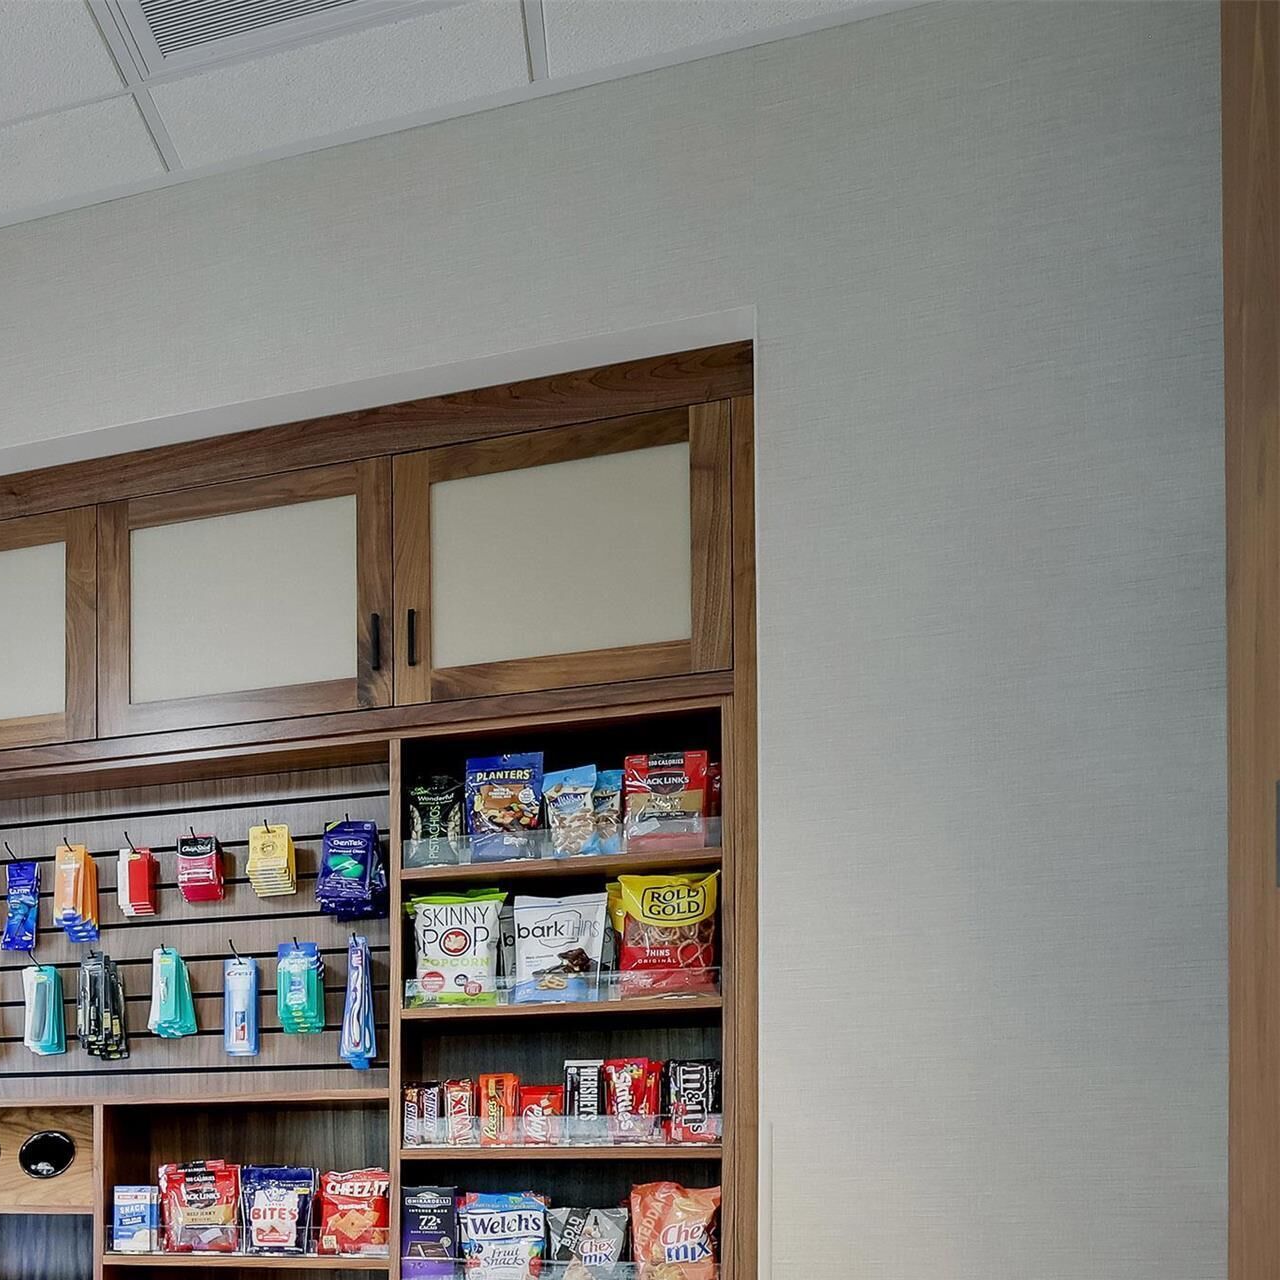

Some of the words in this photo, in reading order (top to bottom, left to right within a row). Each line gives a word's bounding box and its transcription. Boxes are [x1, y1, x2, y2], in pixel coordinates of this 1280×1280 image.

[658, 758, 684, 766] CALORIES
[476, 770, 531, 782] PLANTERS
[418, 793, 454, 801] Wonderful
[428, 806, 441, 859] PISTACHIOS
[651, 889, 699, 904] ROLD
[649, 901, 700, 916] GOLD
[422, 906, 489, 927] SKINNY
[422, 926, 489, 957] POP
[422, 958, 489, 967] POPCORN
[614, 1070, 634, 1130] Skittles
[252, 1207, 298, 1220] BITES
[470, 1214, 541, 1235] Welch's
[562, 1216, 580, 1246] BOLD
[492, 1247, 520, 1258] Fruit
[579, 1240, 616, 1255] Chex
[667, 1242, 711, 1262] mix
[484, 1256, 526, 1268] Snacks
[583, 1254, 614, 1265] mix
